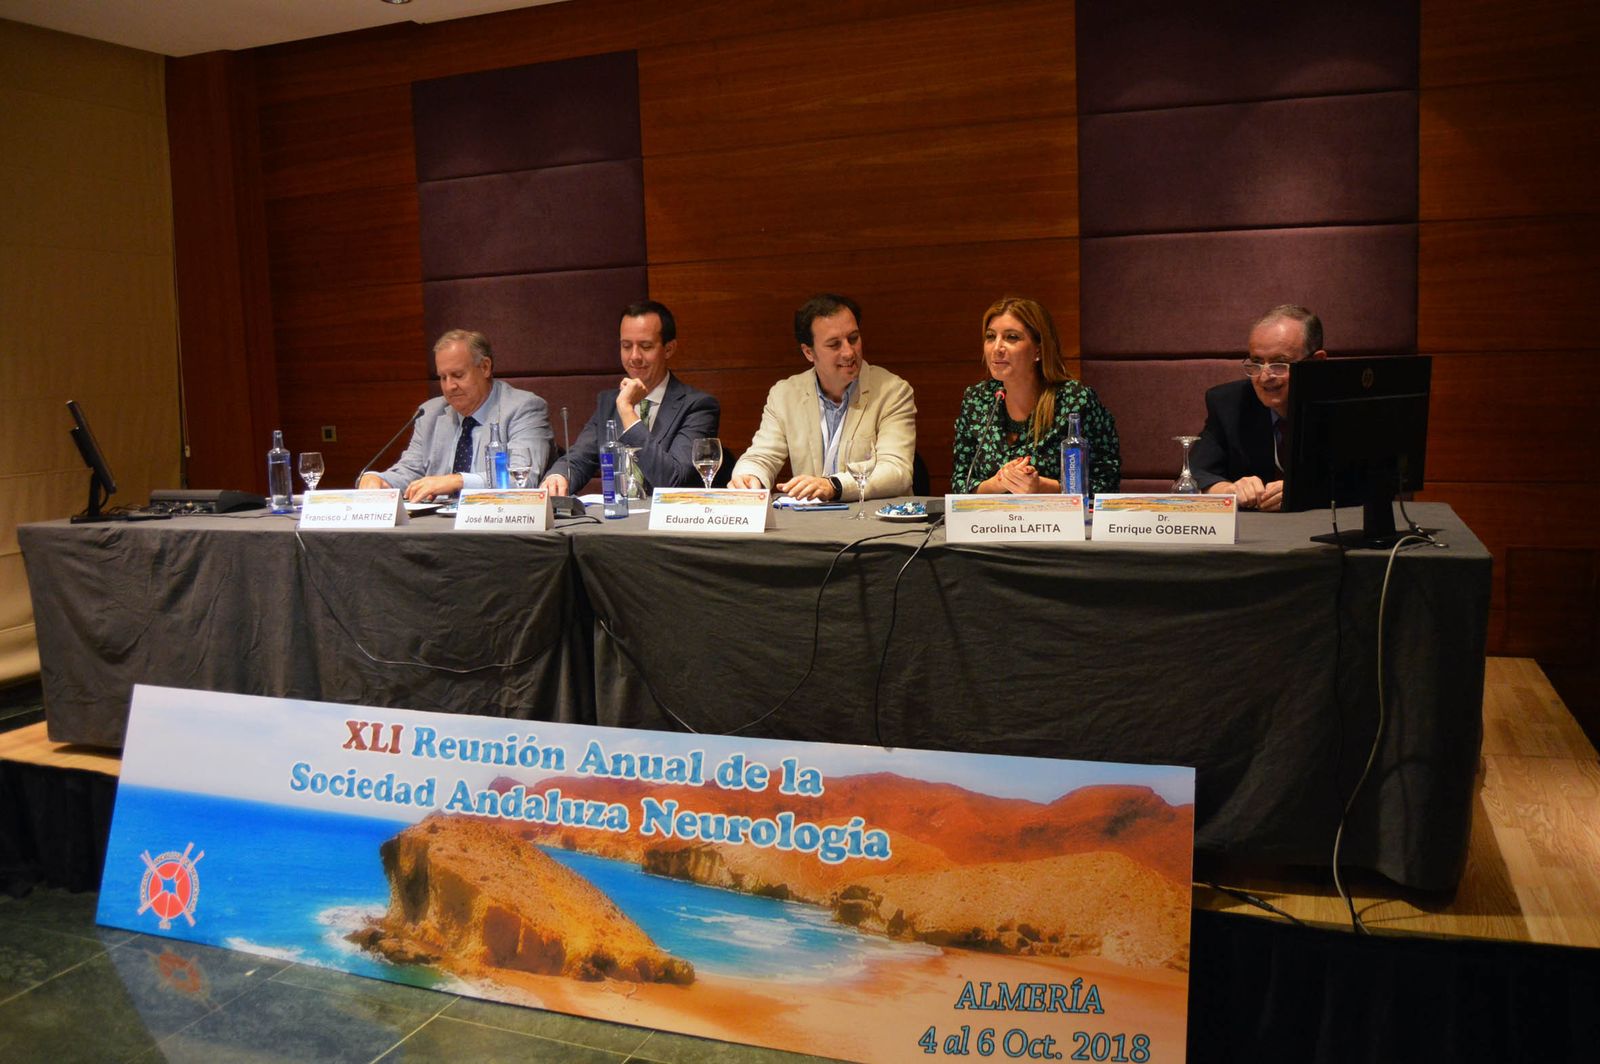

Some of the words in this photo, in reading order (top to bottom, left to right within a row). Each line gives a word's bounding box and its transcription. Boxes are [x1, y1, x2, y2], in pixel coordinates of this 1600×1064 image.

[305, 513, 341, 521] Francisco
[465, 515, 482, 523] José
[666, 515, 704, 524] Eduardo
[707, 514, 749, 525] AGÜERA
[1008, 513, 1025, 521] Sra.
[1157, 514, 1170, 522] Dr.
[970, 524, 1017, 533] Carolina
[1020, 524, 1061, 533] LAFITA
[1108, 524, 1152, 535] Enrique
[1155, 525, 1217, 535] GOBERNA
[342, 720, 404, 754] XLI
[411, 727, 566, 771] Reunión
[577, 740, 704, 786] Anual
[716, 753, 769, 791] de
[779, 757, 824, 797] la
[290, 762, 436, 807] Sociedad
[445, 779, 630, 832] Andaluza
[640, 798, 892, 863] Neurología
[954, 977, 1105, 1014] ALMERÍA
[918, 1026, 937, 1054] 4
[943, 1025, 971, 1055] al
[976, 1028, 995, 1056] 6
[1003, 1029, 1063, 1060] Oct.
[1071, 1032, 1151, 1063] 2018
